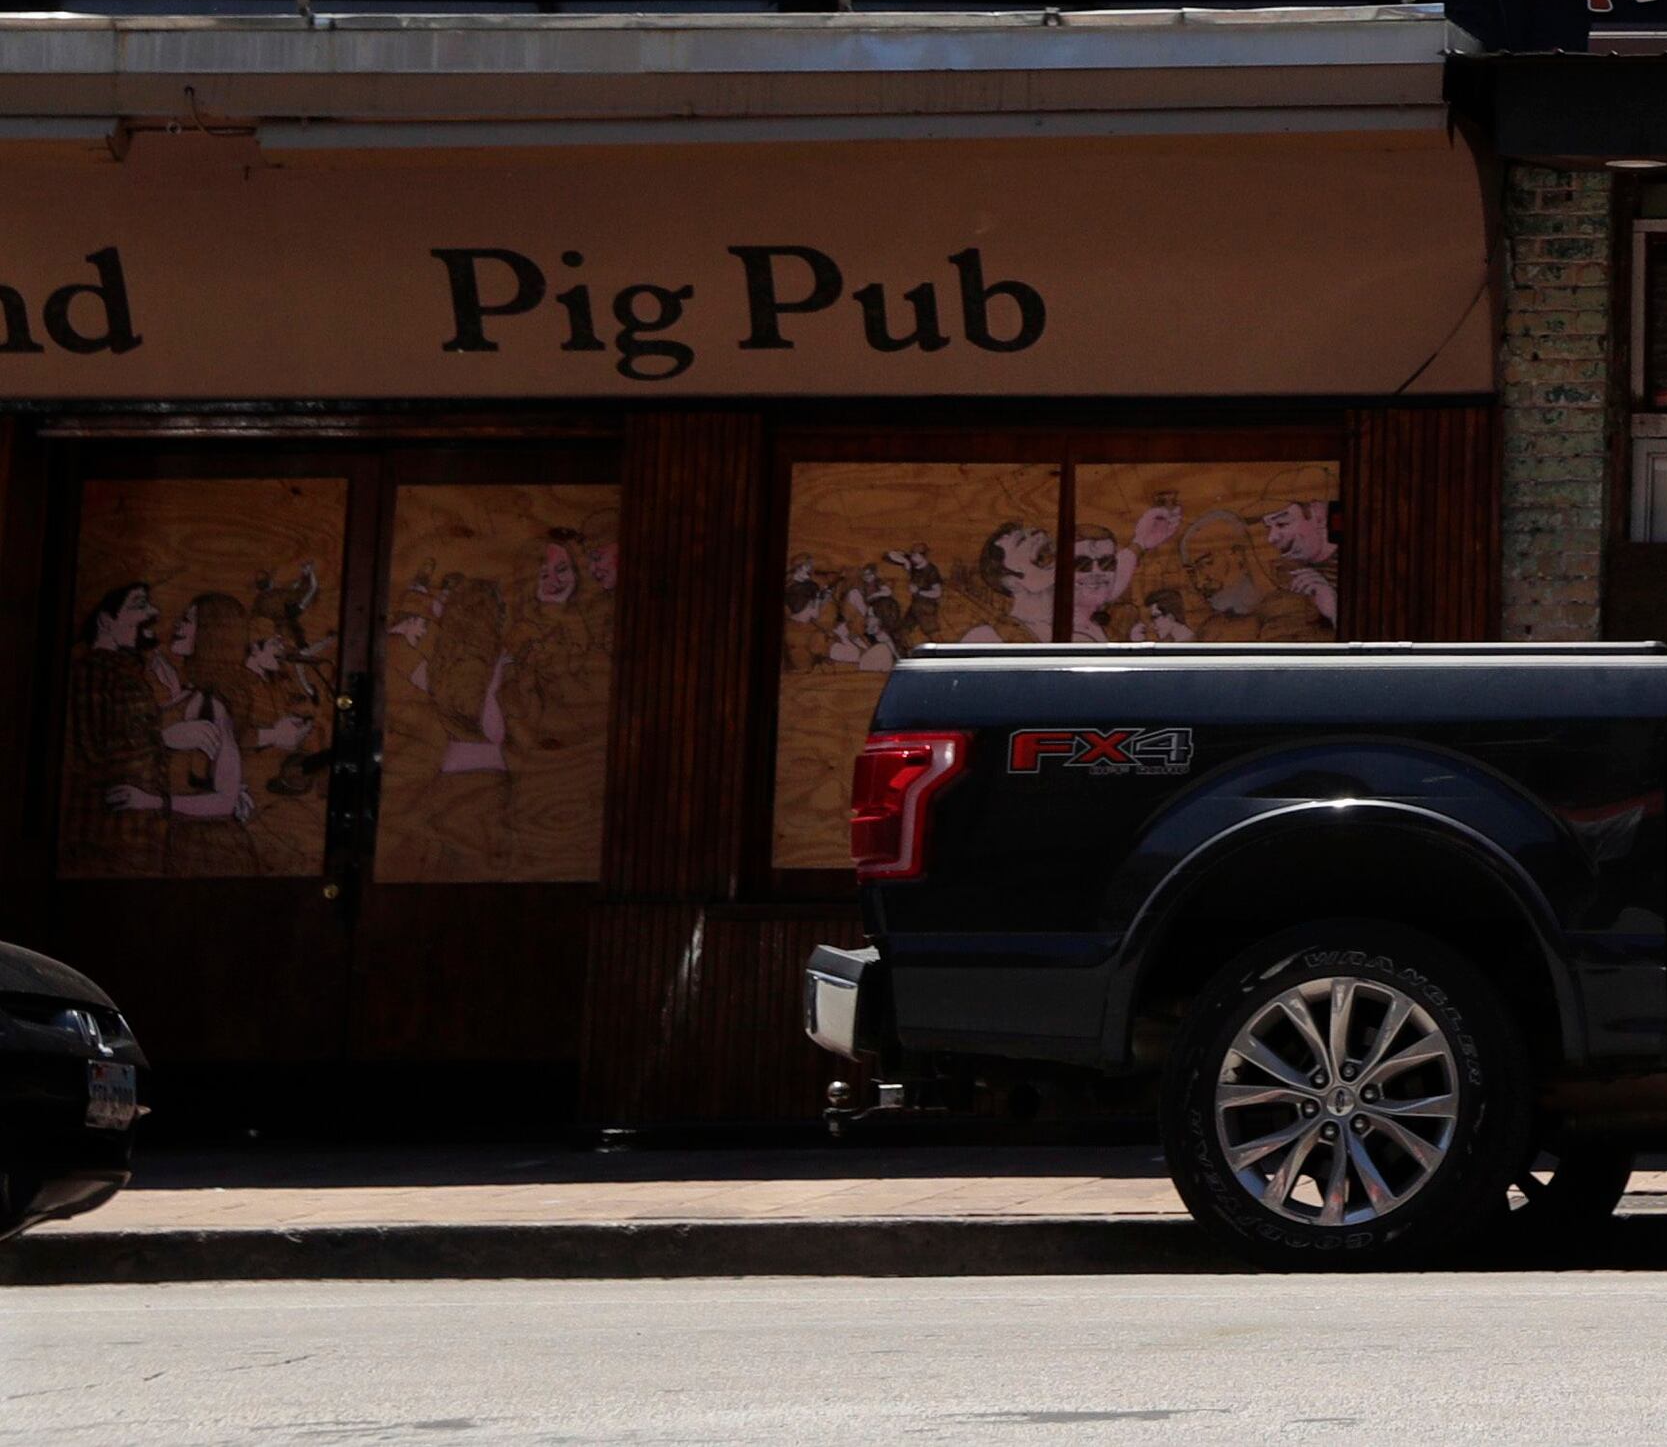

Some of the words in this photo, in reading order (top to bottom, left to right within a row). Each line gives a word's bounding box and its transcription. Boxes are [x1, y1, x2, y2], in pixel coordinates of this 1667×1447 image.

[429, 246, 695, 381] Pig
[728, 245, 1048, 353] Pub
[1007, 727, 1194, 774] FX4
